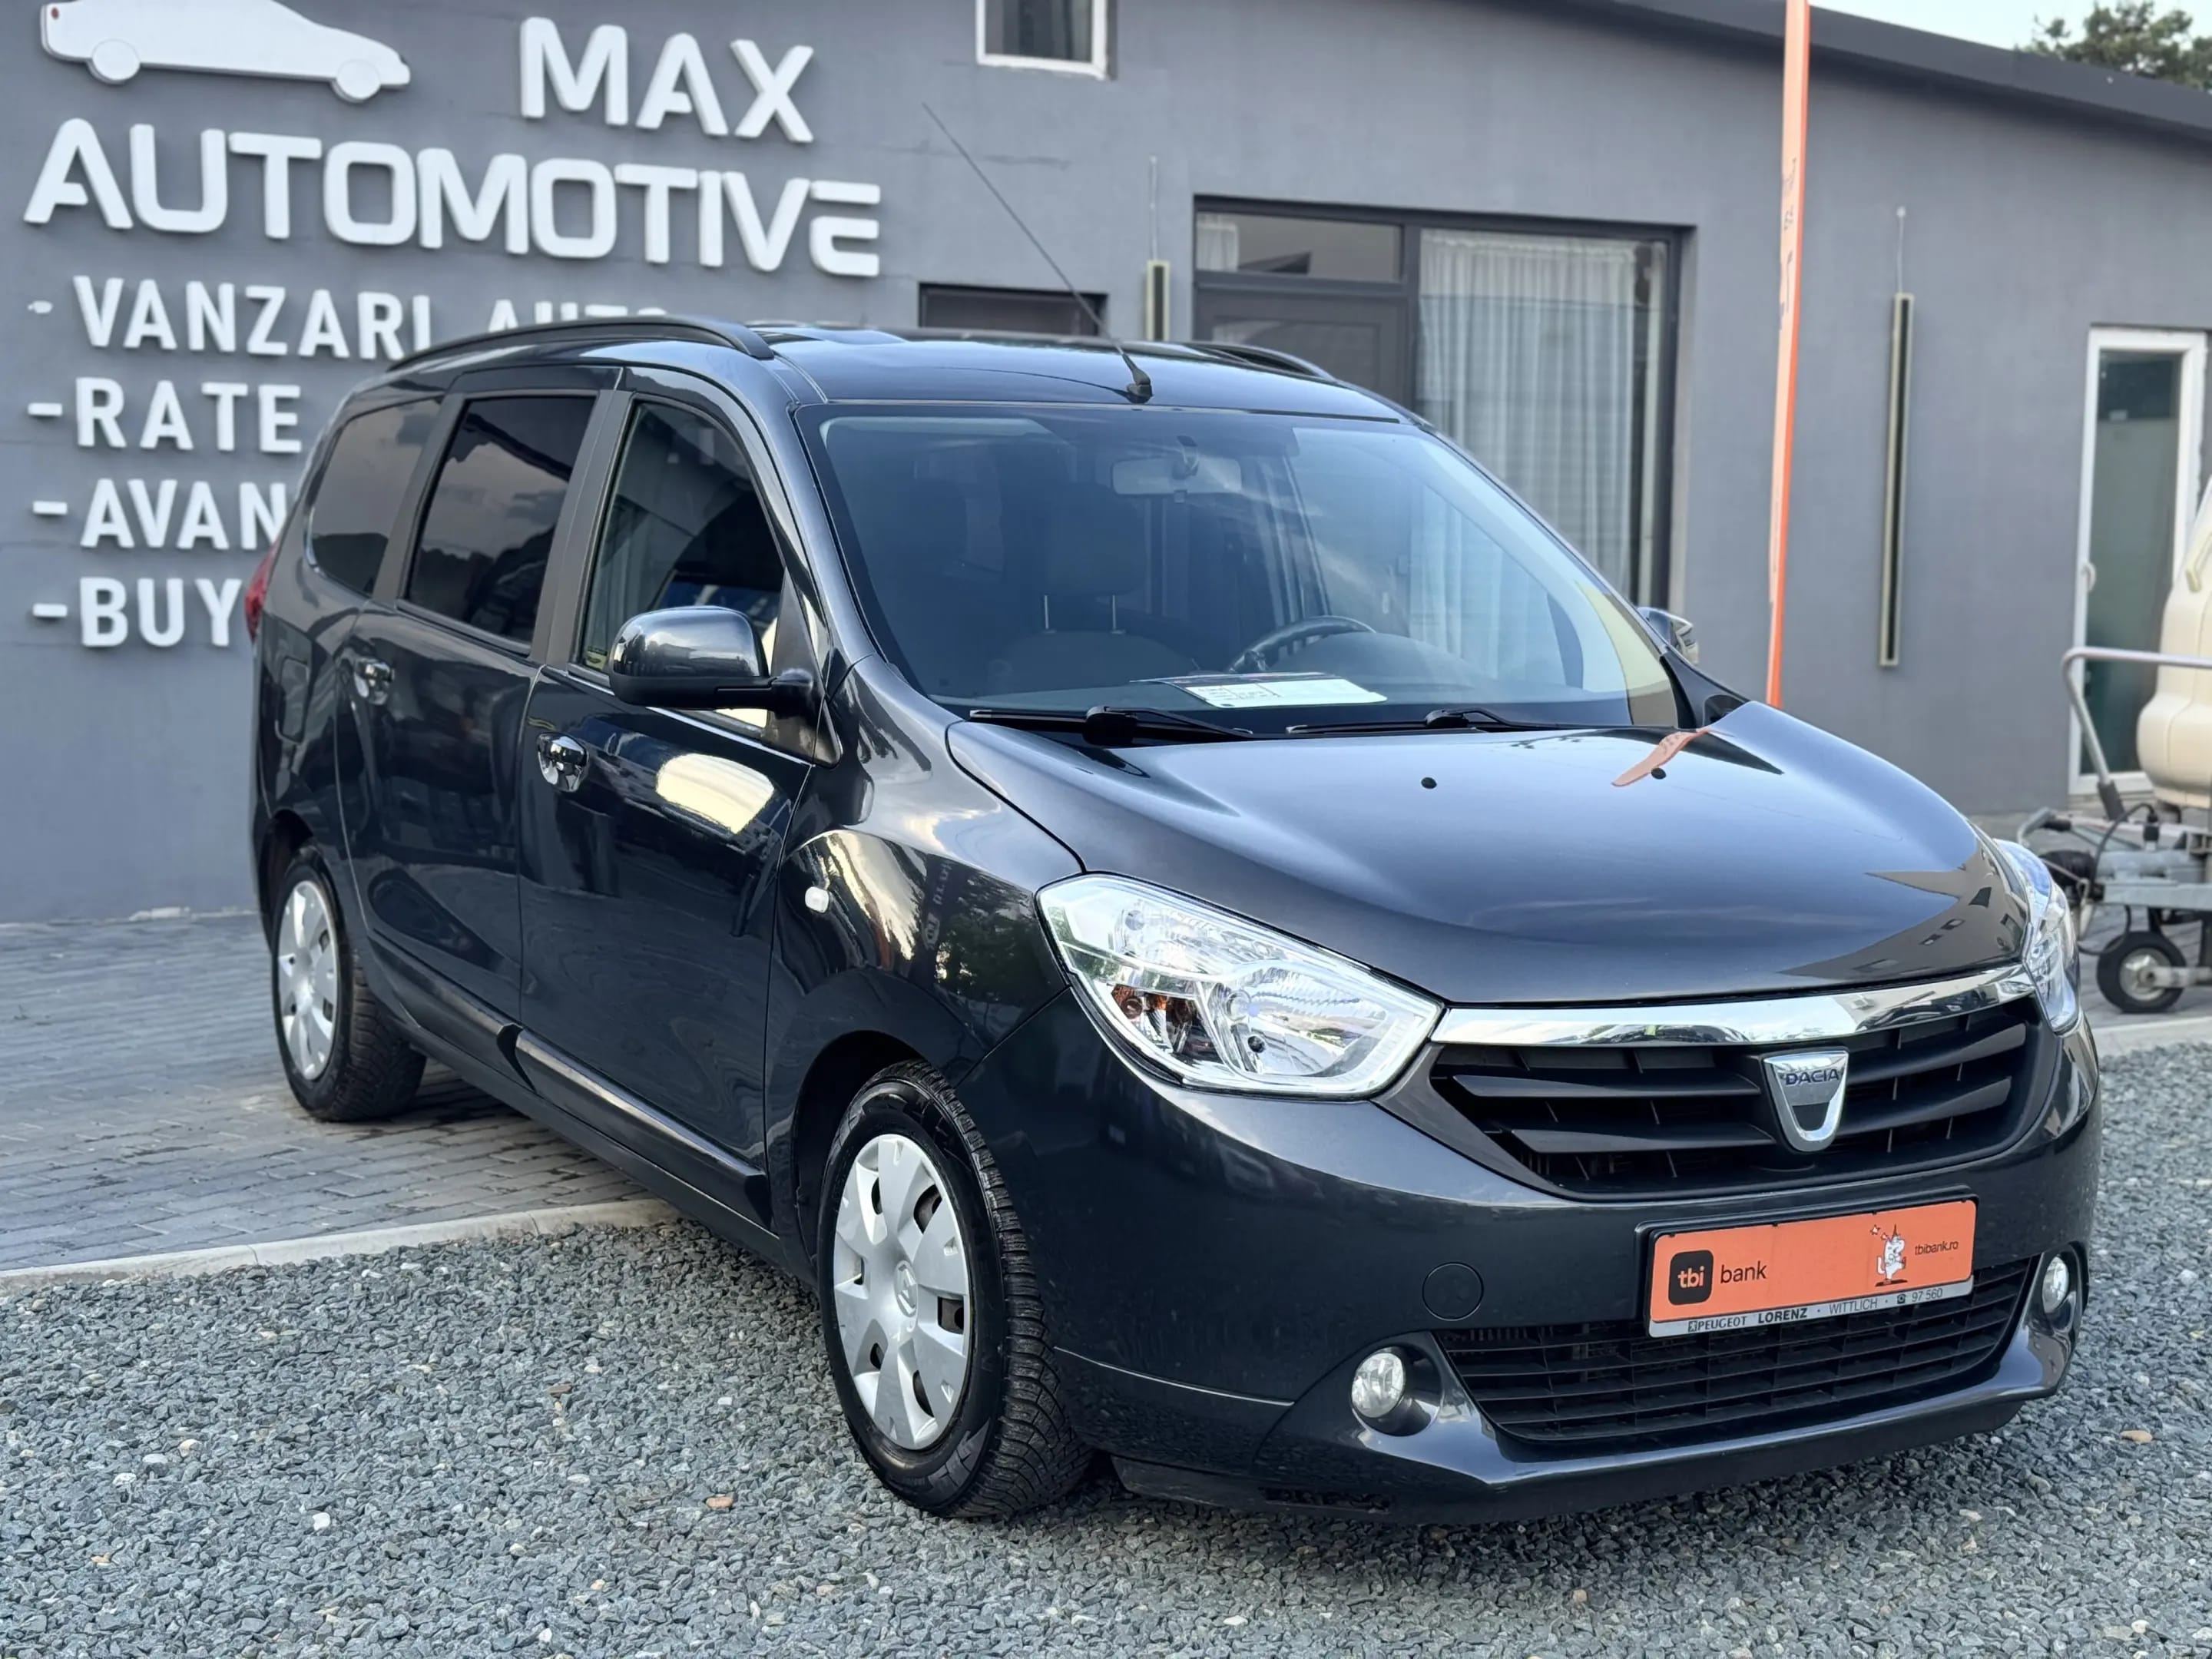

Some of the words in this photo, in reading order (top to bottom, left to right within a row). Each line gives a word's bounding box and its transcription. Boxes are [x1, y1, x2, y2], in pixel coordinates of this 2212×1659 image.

[520, 16, 814, 143] MAX
[24, 118, 880, 277] AUTOMOTIVE
[1785, 1068, 1839, 1085] DACIA
[1915, 1240, 1959, 1256] tbibank.ro
[1677, 1265, 1704, 1288] tbi
[1720, 1260, 1767, 1283] bank
[1697, 1316, 1747, 1331] PEUGEOT
[1758, 1308, 1808, 1323] LORENZ
[1829, 1298, 1878, 1314] WITTLICH
[1912, 1290, 1923, 1302] 97
[1926, 1287, 1943, 1300] 560
